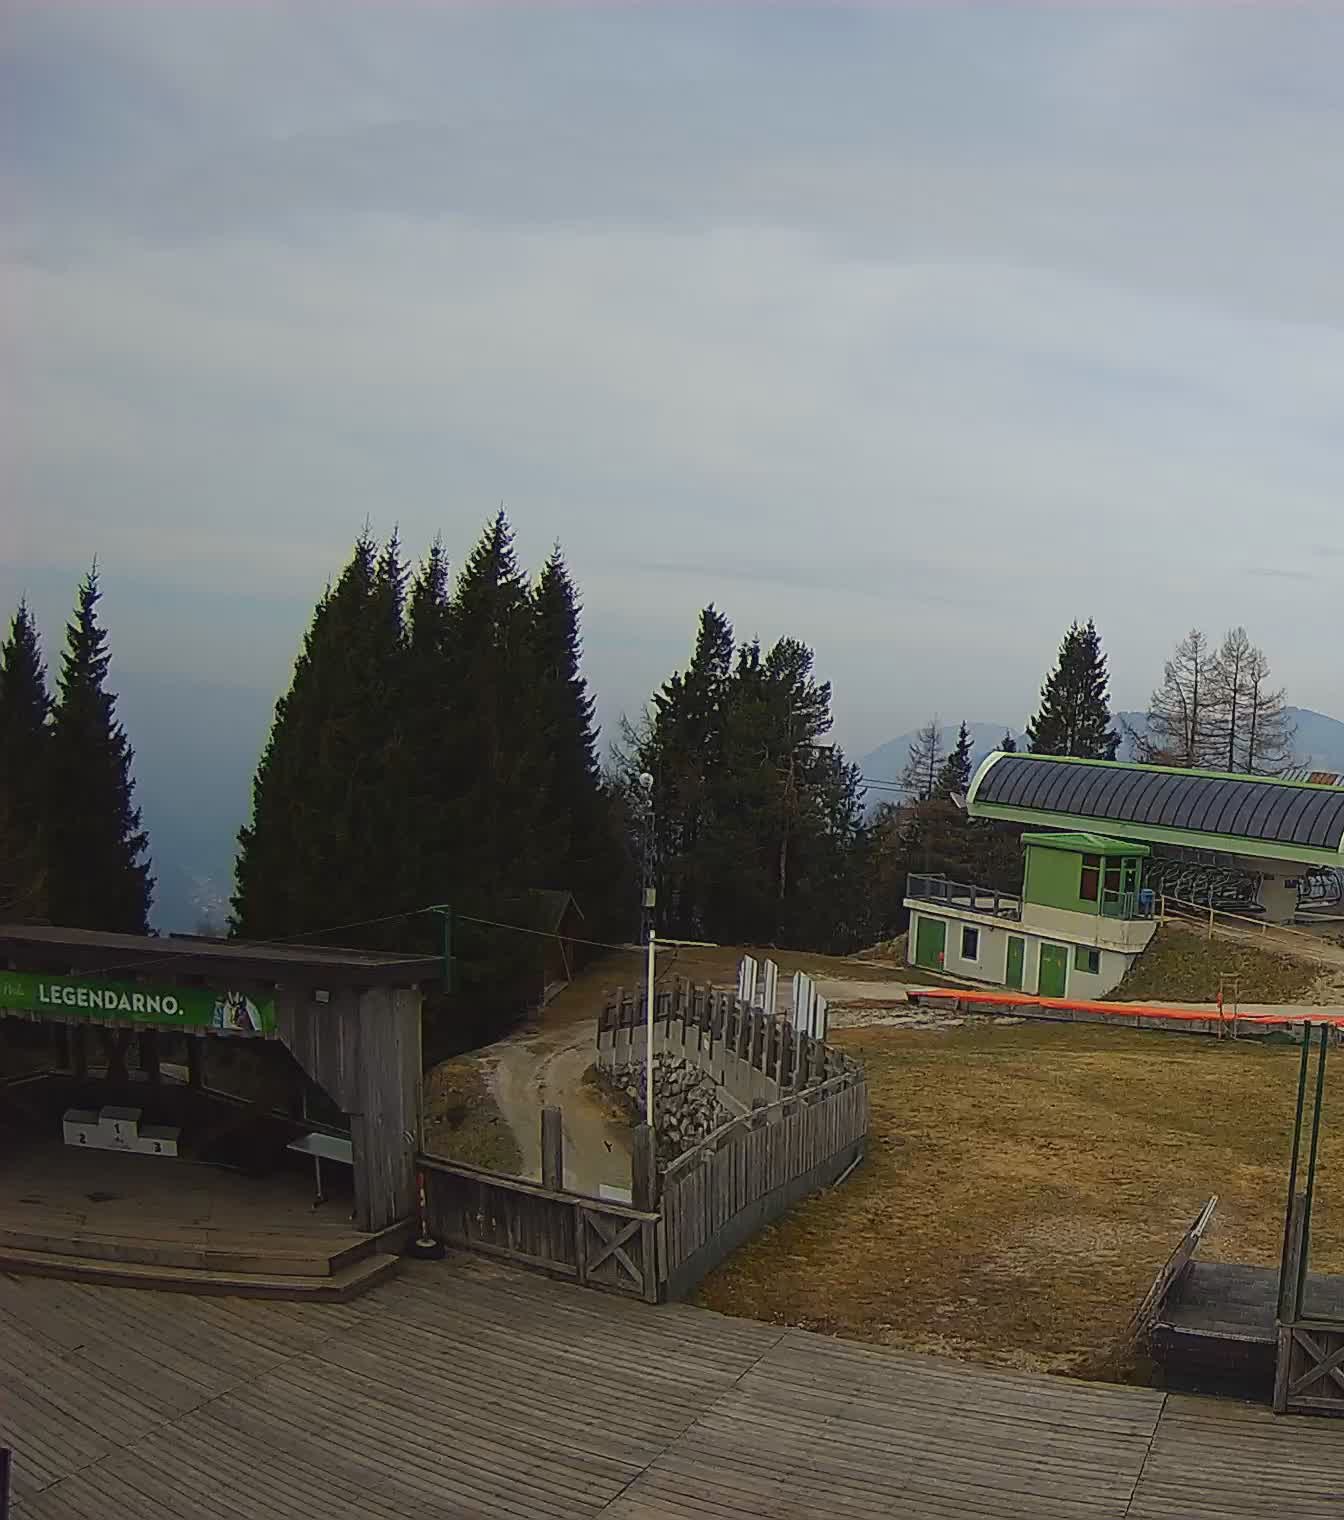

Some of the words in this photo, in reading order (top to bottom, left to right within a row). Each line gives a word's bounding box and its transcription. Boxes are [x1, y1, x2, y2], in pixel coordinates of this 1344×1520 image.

[38, 983, 184, 1016] LEGENDARNO.
[79, 1133, 86, 1145] 2
[153, 1141, 162, 1152] 3
